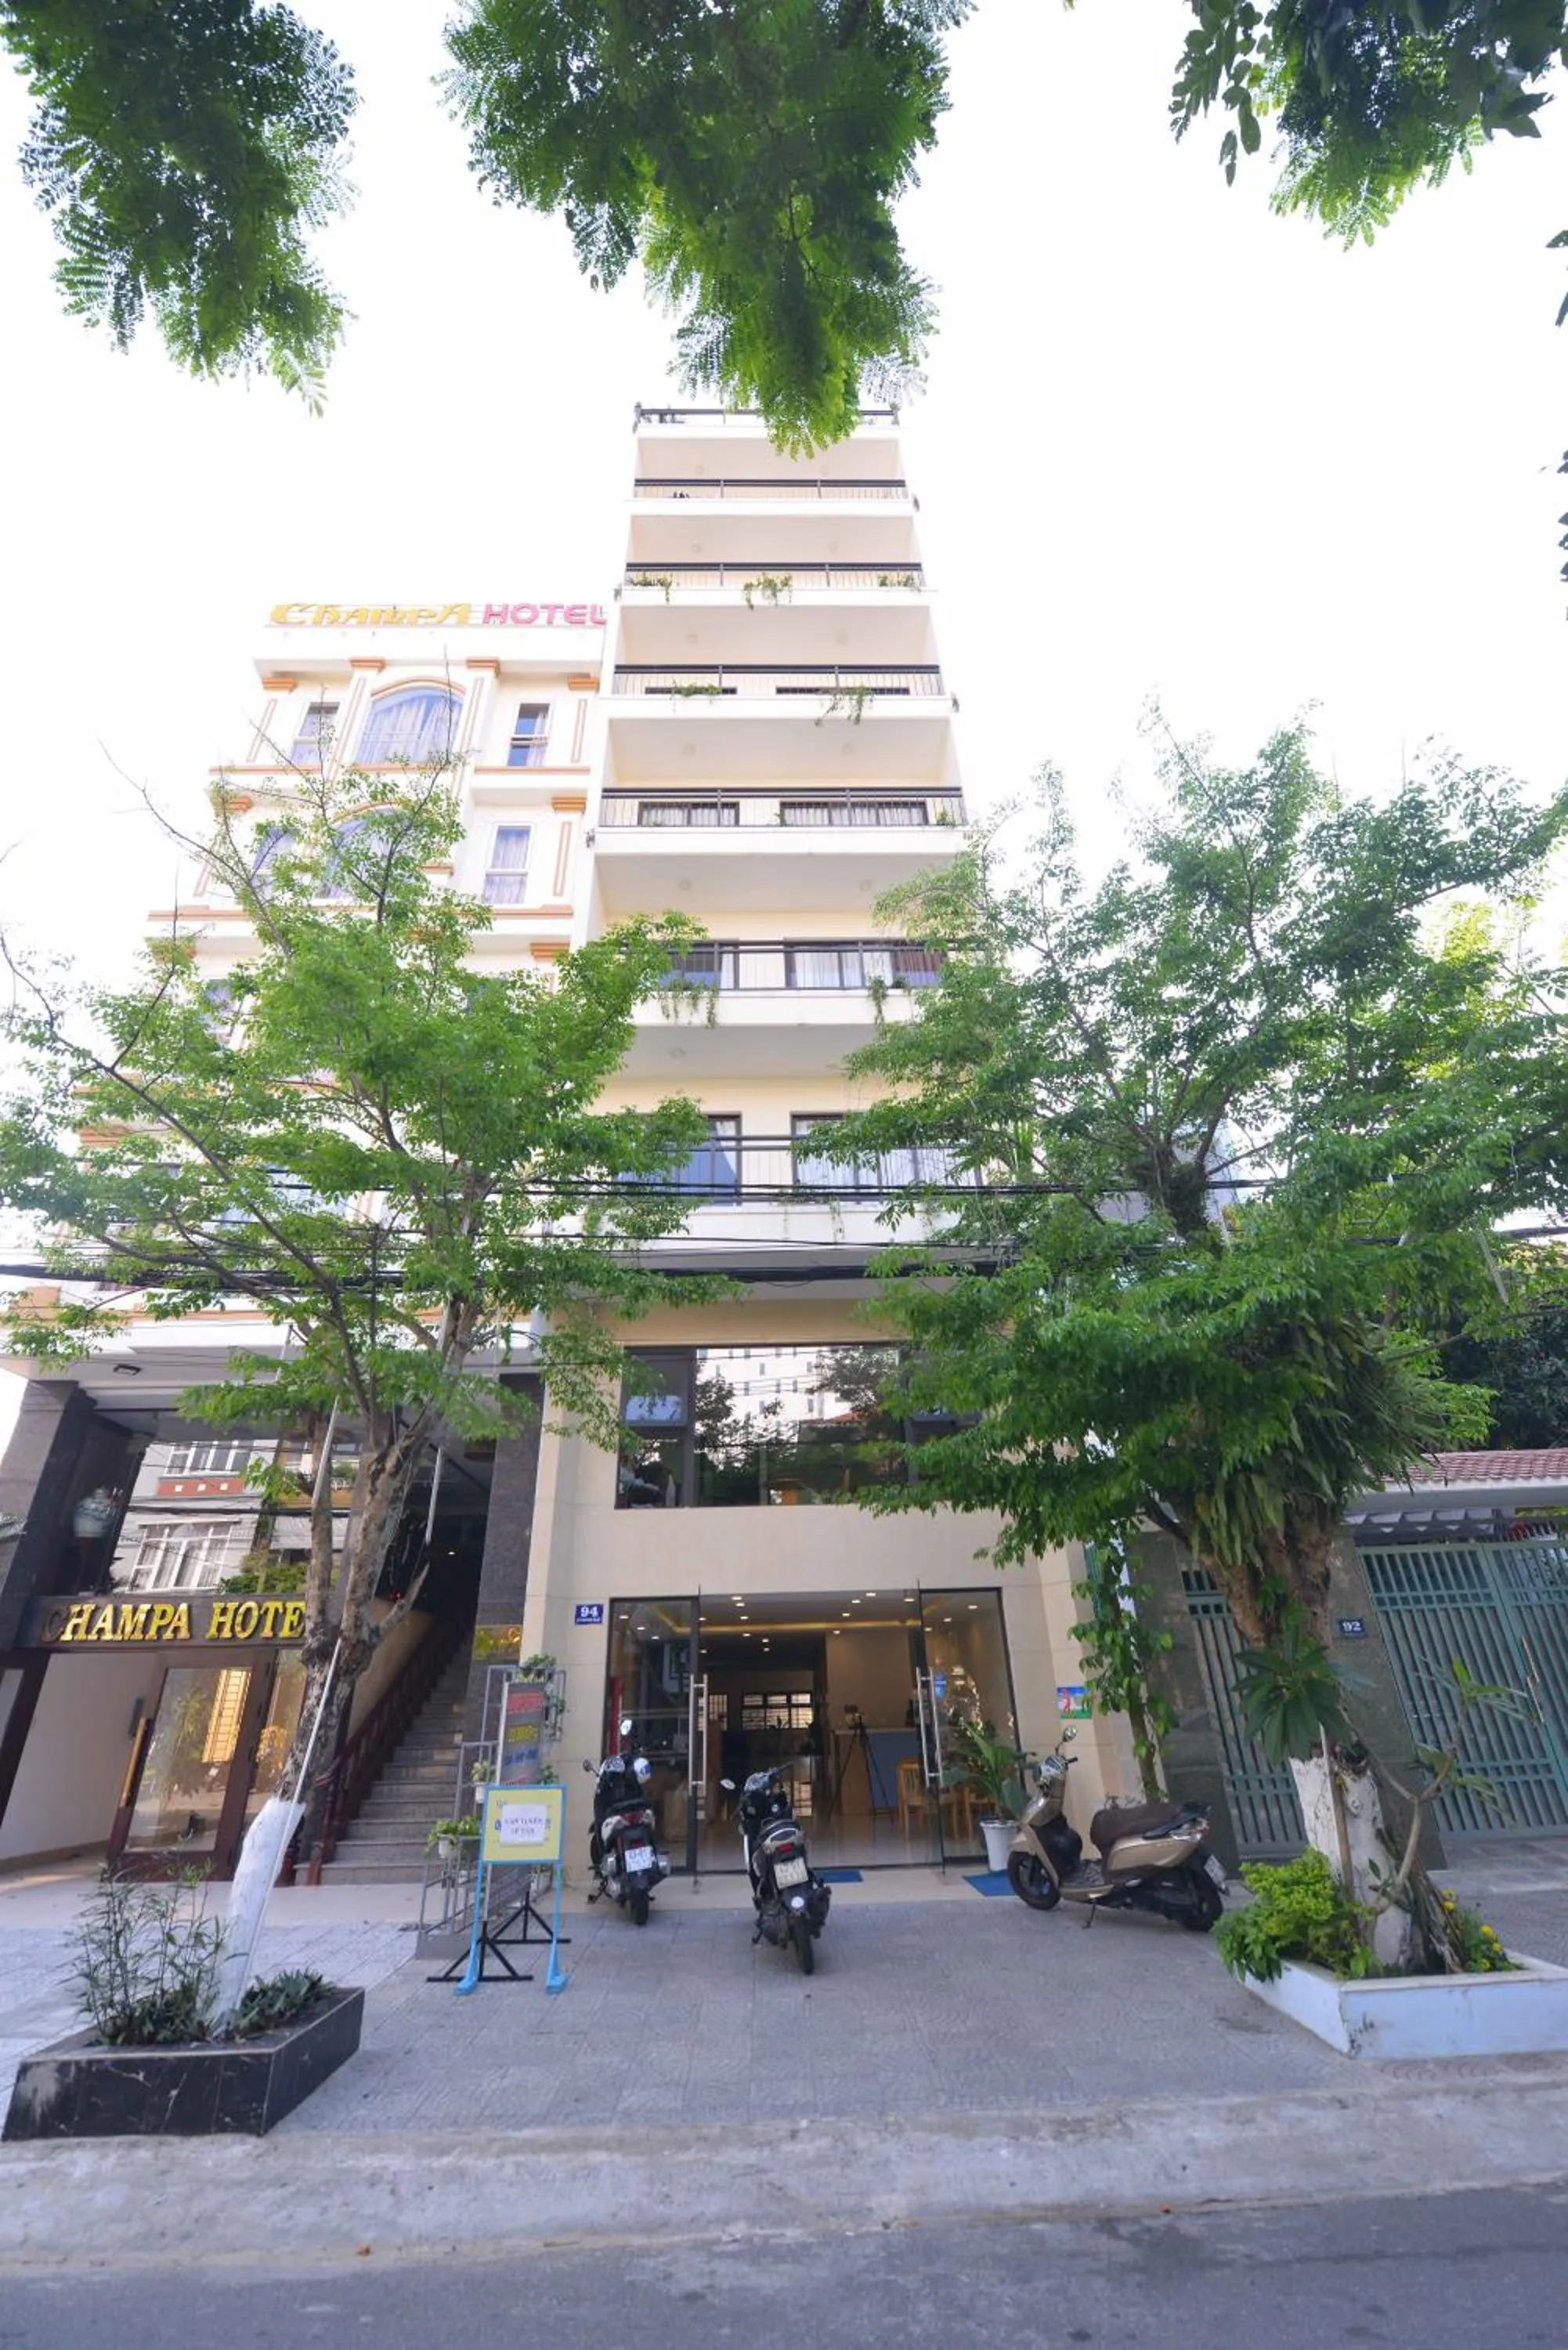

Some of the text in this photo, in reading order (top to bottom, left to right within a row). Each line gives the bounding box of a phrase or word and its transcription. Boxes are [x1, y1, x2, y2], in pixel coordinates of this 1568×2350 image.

[482, 602, 607, 625] HOTEL
[580, 1605, 598, 1618] 94
[42, 1600, 307, 1642] CHAMPA HOTE
[1342, 1620, 1361, 1632] 92
